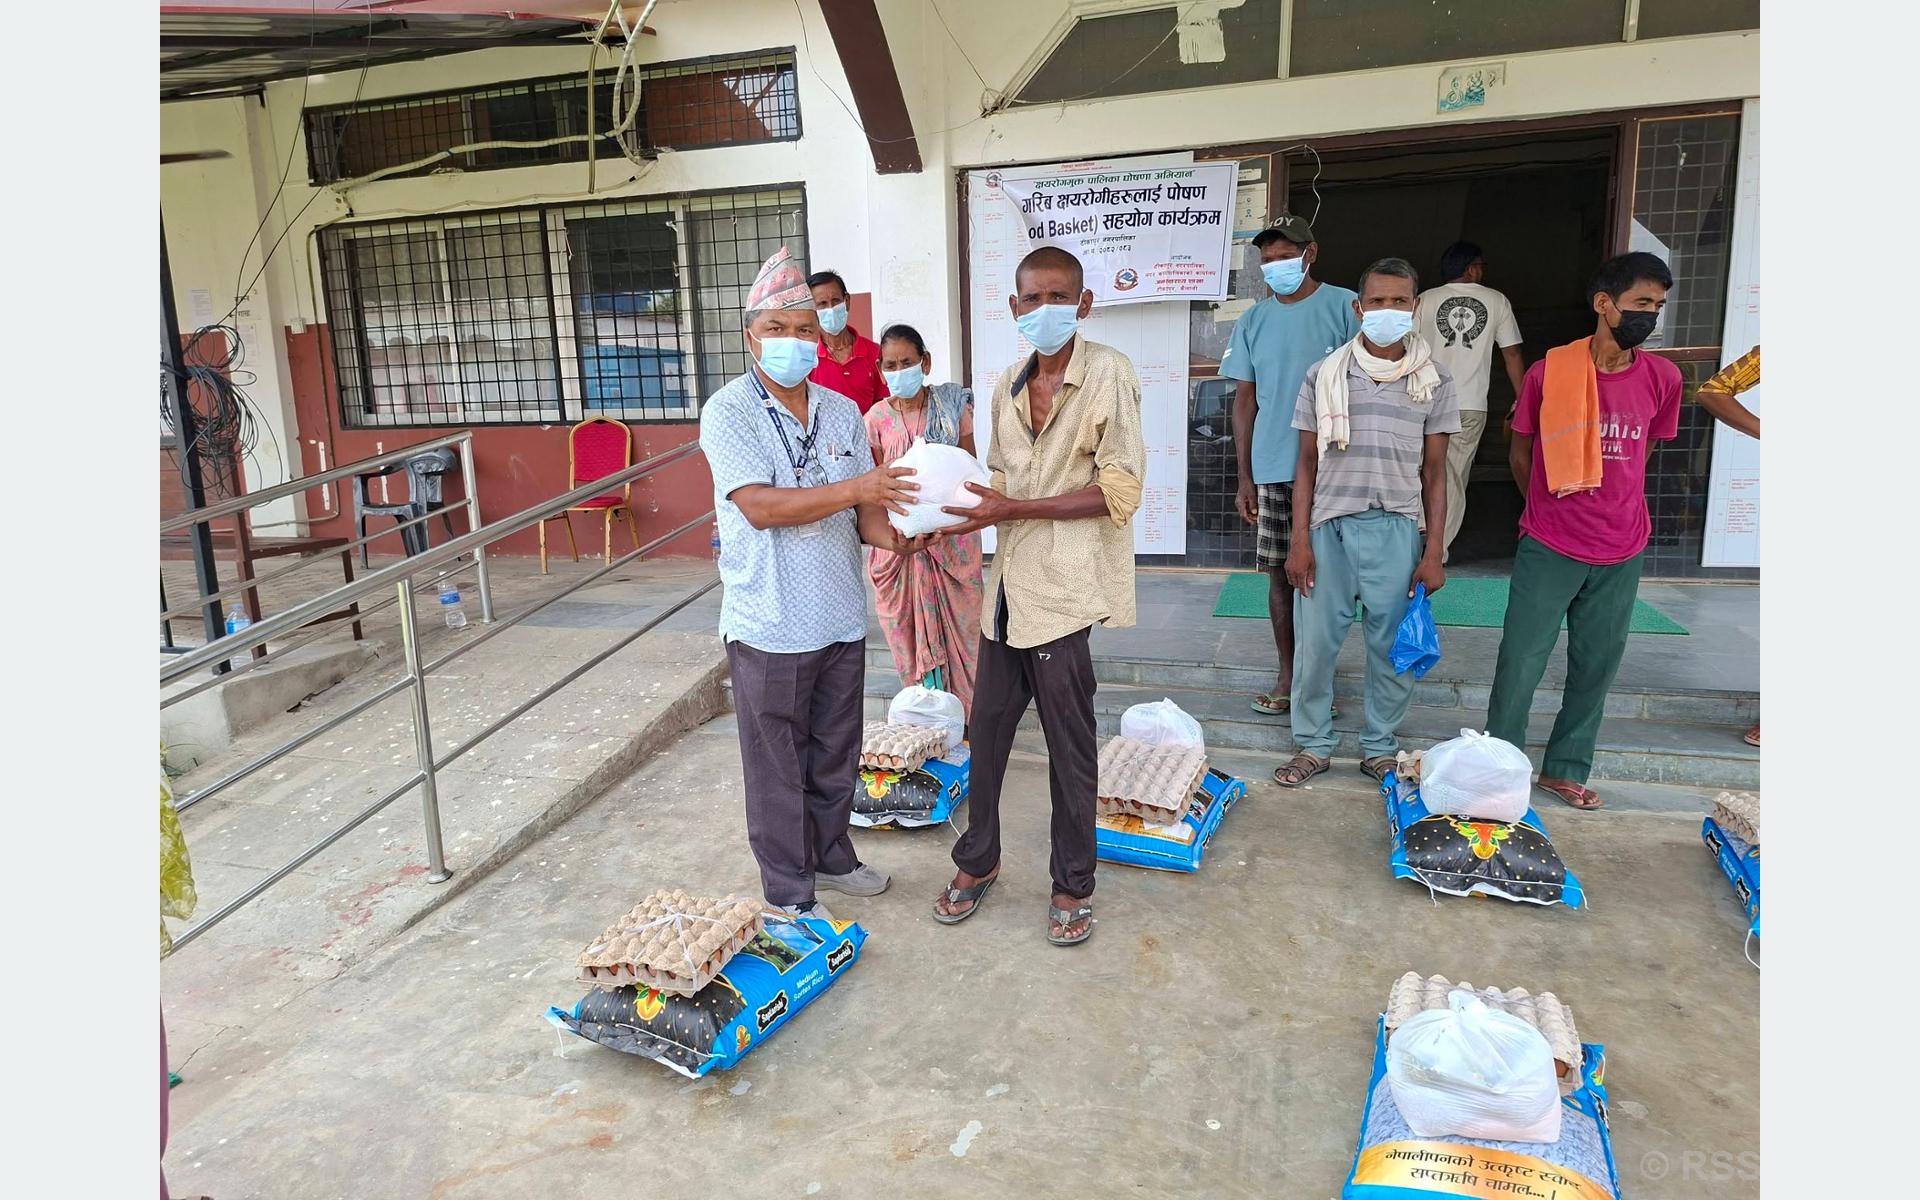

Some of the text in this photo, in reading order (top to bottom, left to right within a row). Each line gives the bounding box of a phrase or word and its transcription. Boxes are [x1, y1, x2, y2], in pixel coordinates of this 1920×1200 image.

[1087, 174, 1120, 185] पालिका
[1123, 172, 1151, 182] घोषणा
[1022, 191, 1053, 213] गरिब
[1057, 183, 1163, 211] क्षयरोगीहरुलाई
[1167, 182, 1207, 200] पोषण
[1048, 214, 1098, 237] Basket)
[1102, 208, 1154, 230] सहयोग
[1158, 206, 1222, 226] कार्यक्रम
[1385, 1149, 1475, 1167] नेपालीपनको
[1478, 1159, 1536, 1178] उत्कृष्ट
[1410, 1167, 1478, 1187] सप्तऋषि
